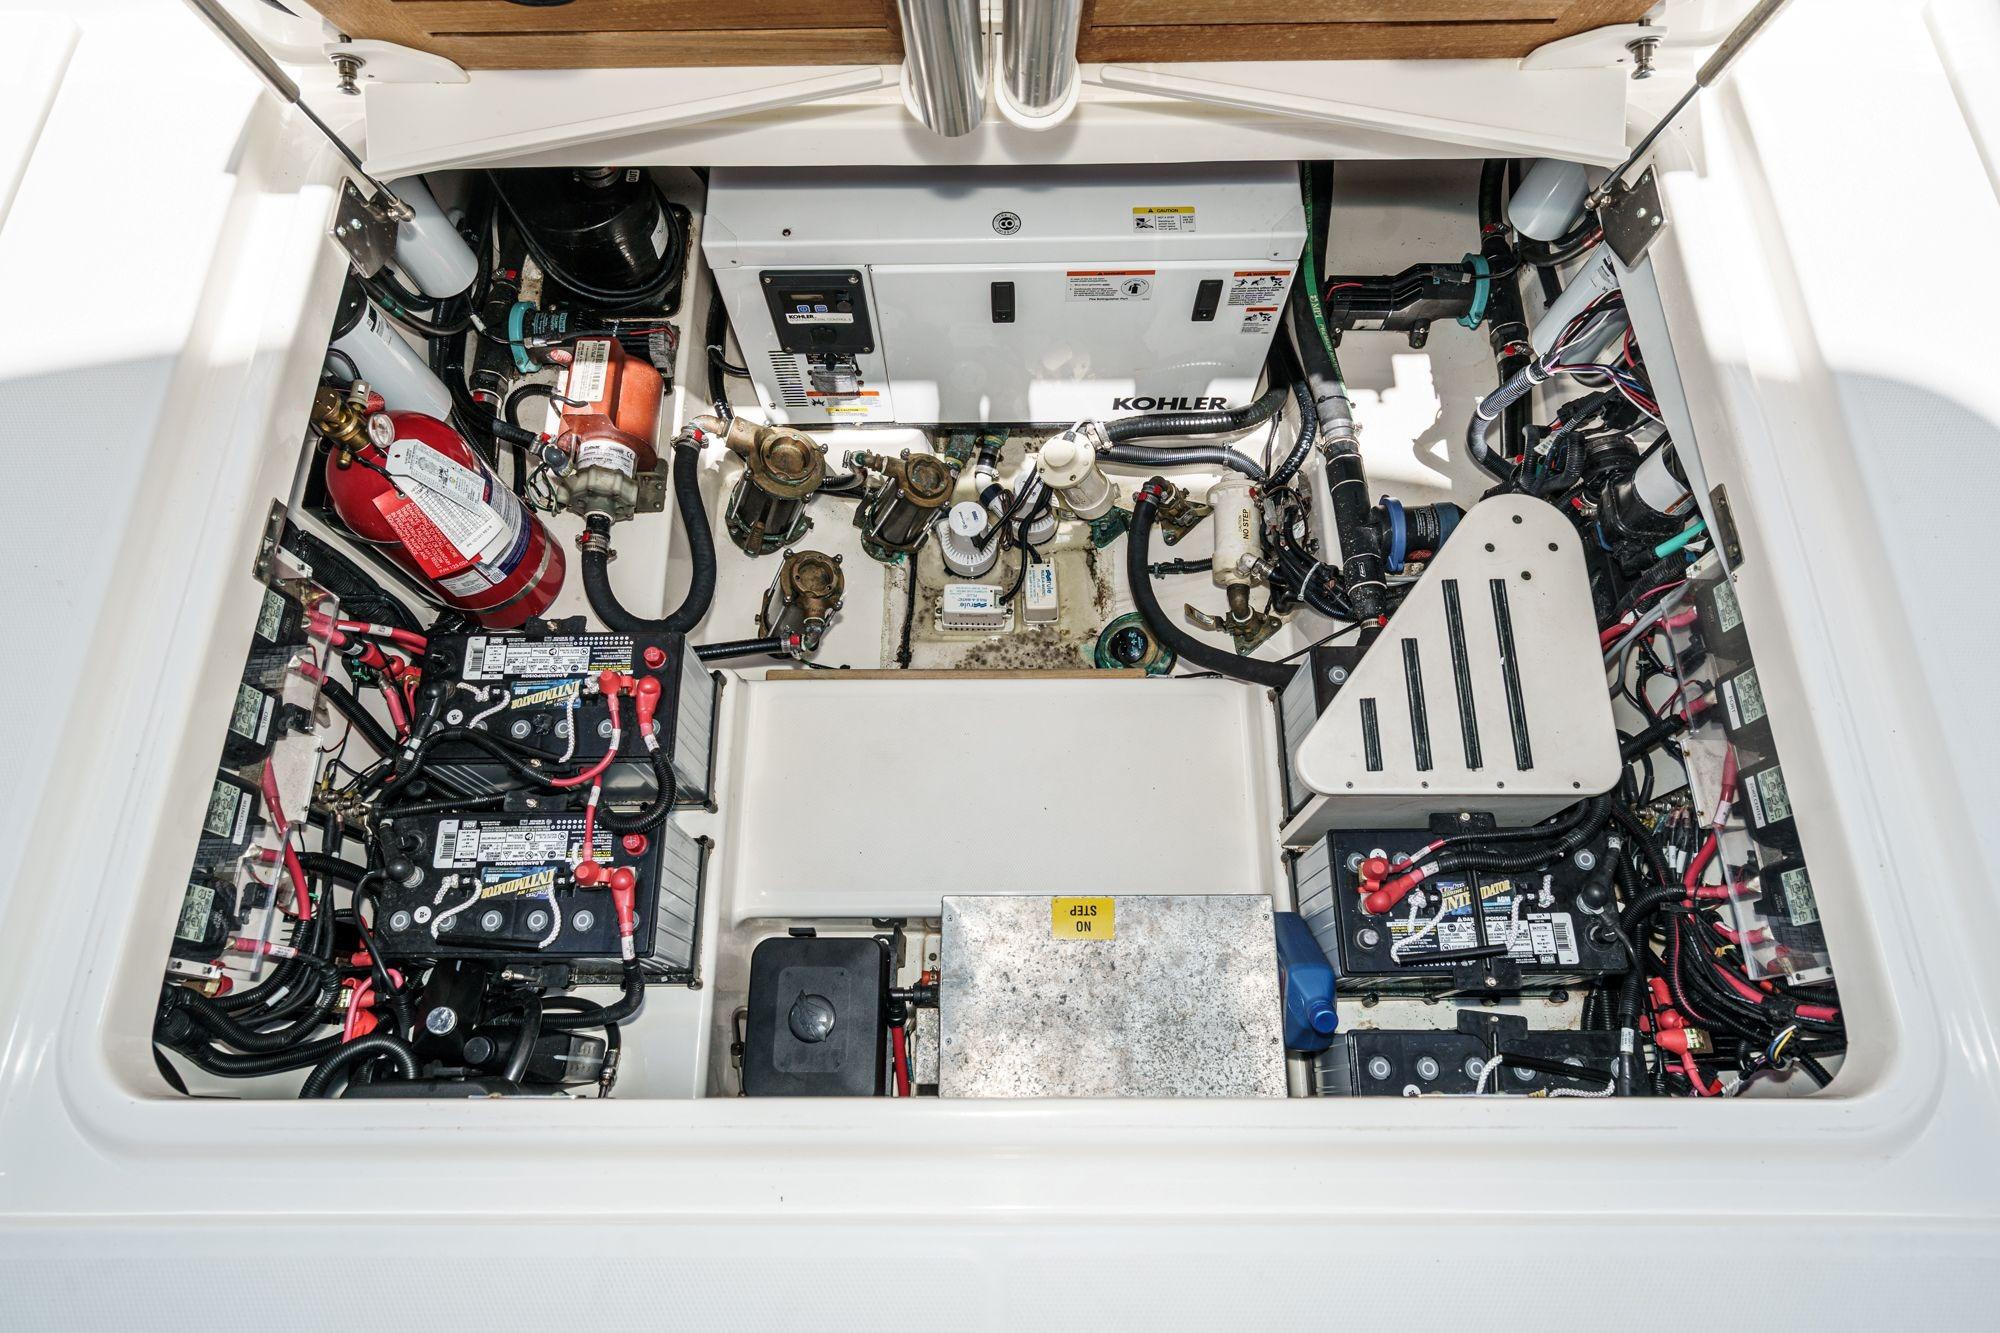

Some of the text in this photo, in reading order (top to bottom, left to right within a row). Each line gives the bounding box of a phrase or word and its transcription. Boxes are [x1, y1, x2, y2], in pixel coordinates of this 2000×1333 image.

[629, 170, 638, 182] OUT
[1112, 396, 1228, 411] KOHLER
[408, 502, 432, 530] ATTEMPTING
[385, 514, 406, 539] EQUIPMENT
[394, 517, 413, 539] PERSONAL
[395, 509, 409, 523] THESE
[404, 522, 427, 550] INSTRUCTIONS
[1242, 528, 1249, 540] NO
[510, 680, 581, 709] INTIMIDATOR
[514, 688, 528, 696] AGM
[1727, 695, 1737, 713] PORT
[238, 799, 249, 822] CENTER
[1752, 798, 1763, 821] CENTER
[479, 868, 556, 899] INTIMIDATOR
[1069, 905, 1097, 916] STEP
[1497, 896, 1511, 905] AGM
[1076, 920, 1092, 932] NO
